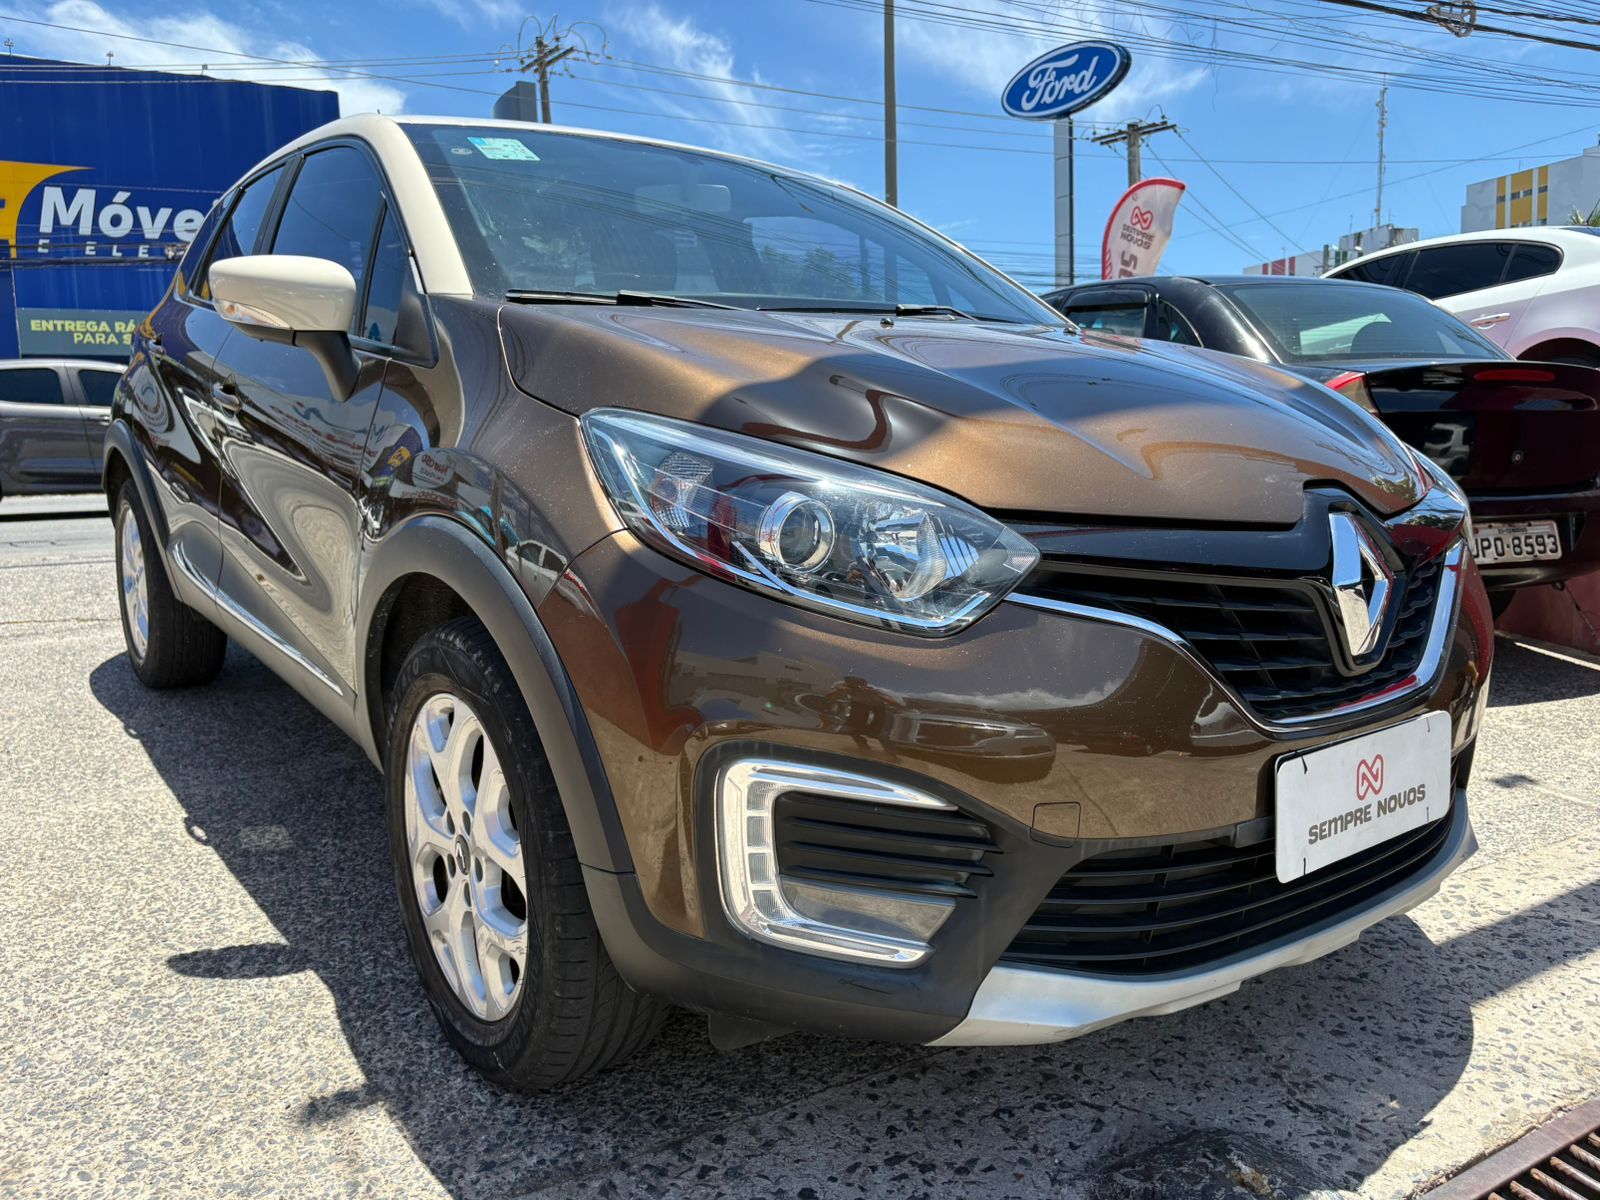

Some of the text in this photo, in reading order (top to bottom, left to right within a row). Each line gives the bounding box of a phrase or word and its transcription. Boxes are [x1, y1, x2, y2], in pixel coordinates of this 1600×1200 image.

[1020, 53, 1099, 111] Ford
[30, 319, 111, 332] ENTREGA
[73, 332, 119, 345] PARA
[1308, 803, 1372, 845] SEMPRE
